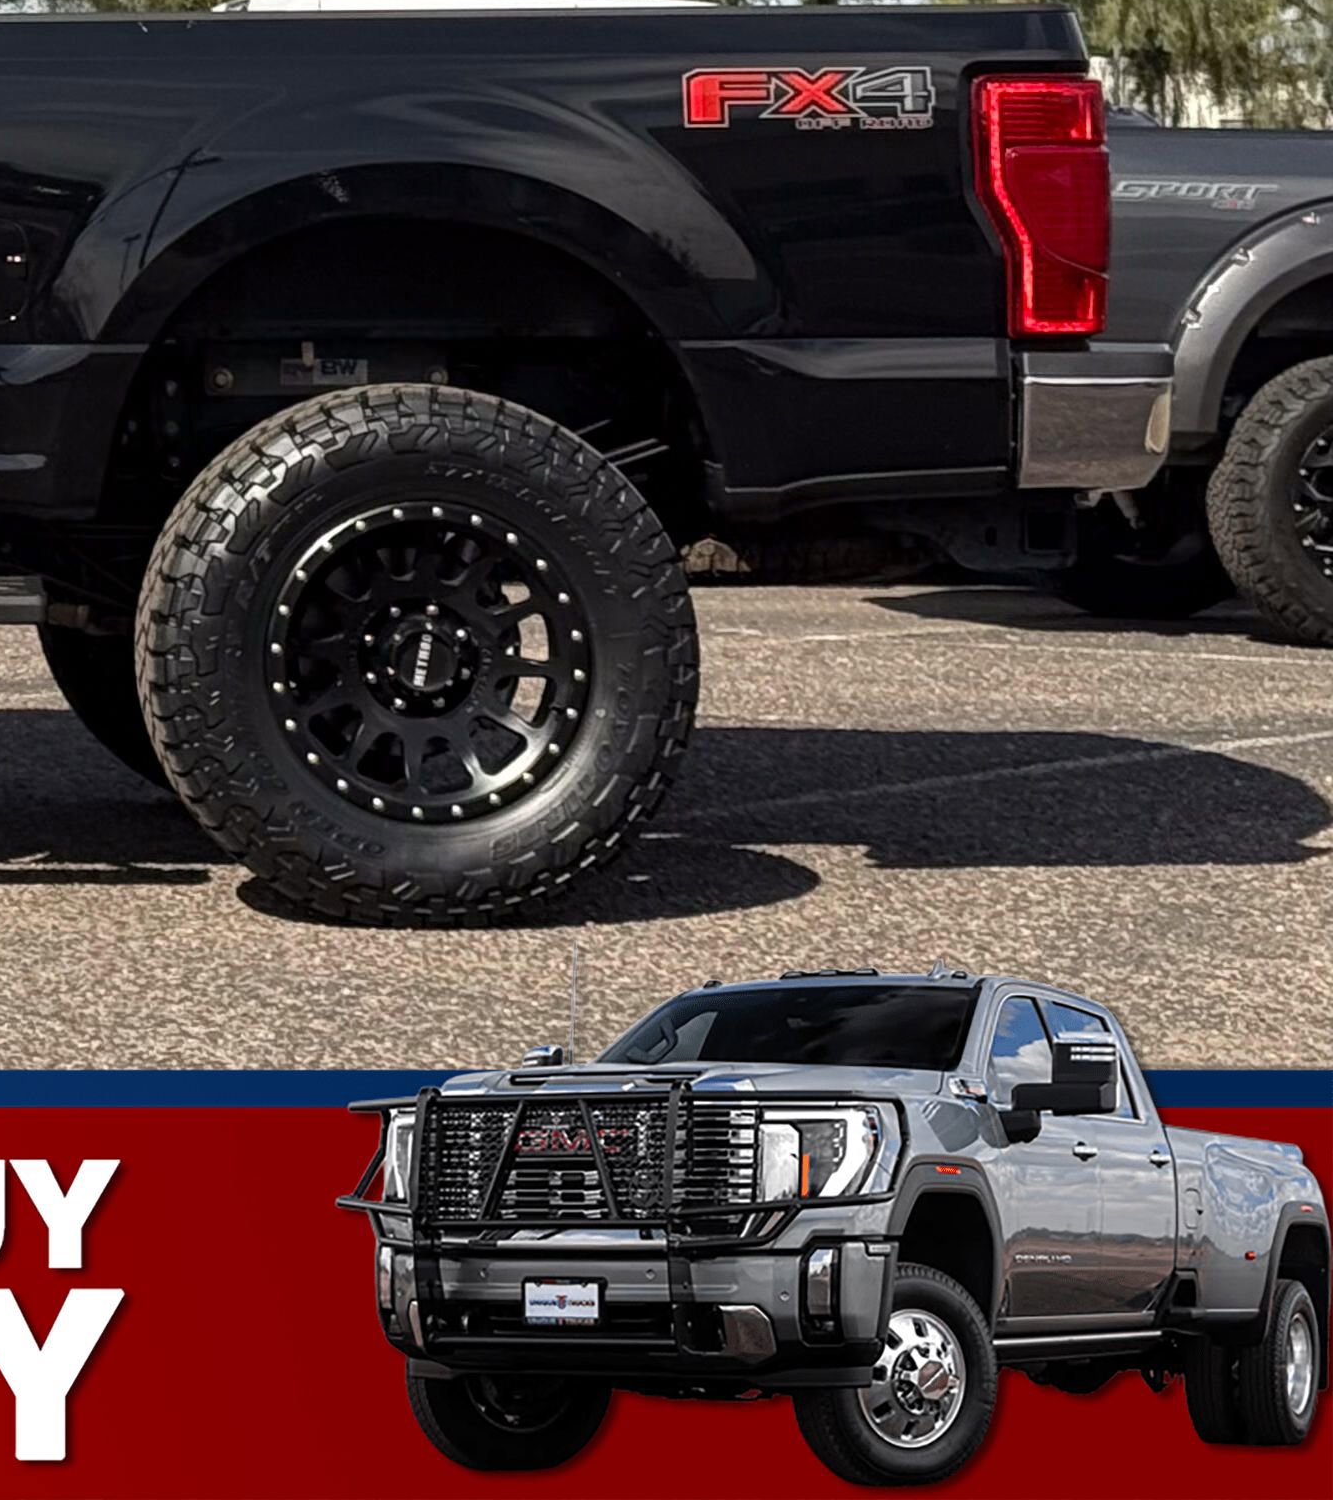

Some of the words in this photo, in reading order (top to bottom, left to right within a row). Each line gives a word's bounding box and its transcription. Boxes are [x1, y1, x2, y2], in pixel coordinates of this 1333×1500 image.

[683, 67, 935, 128] FX4
[1111, 180, 1279, 202] SPORT
[413, 633, 433, 687] METHOD
